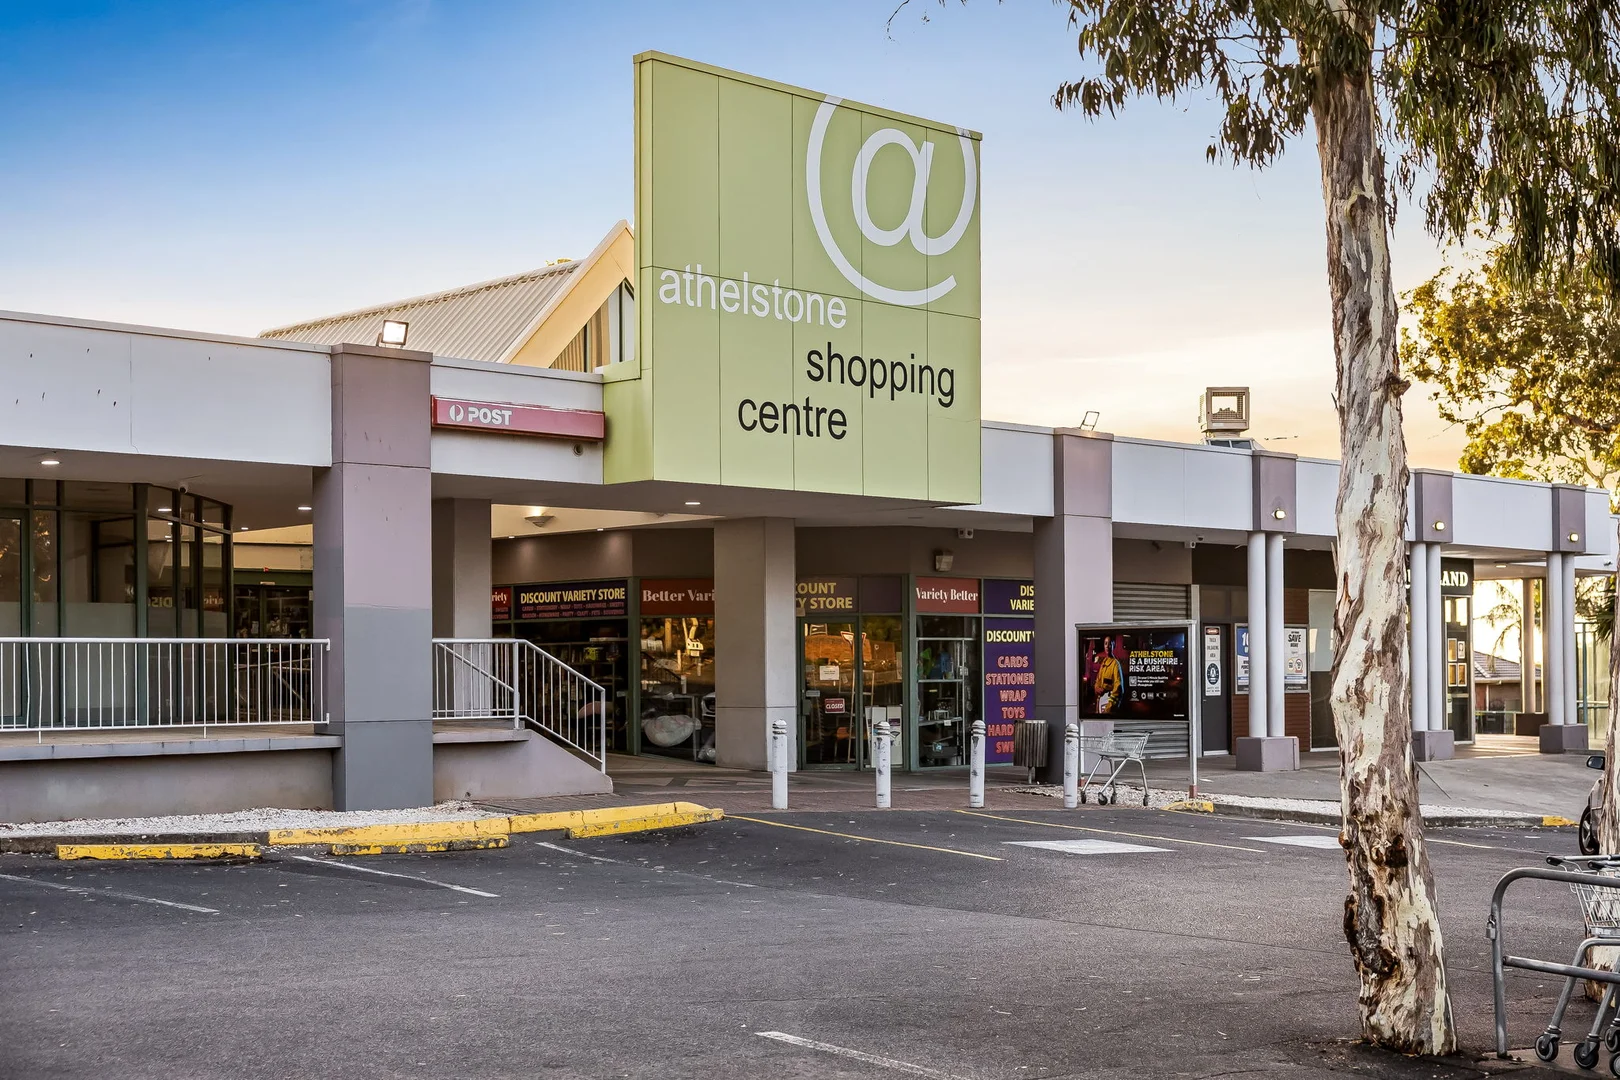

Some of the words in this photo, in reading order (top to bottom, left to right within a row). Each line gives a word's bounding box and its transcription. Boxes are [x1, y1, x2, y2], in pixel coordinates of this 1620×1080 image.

[659, 263, 847, 329] athelstone
[806, 342, 955, 408] shopping
[468, 406, 512, 425] POST
[738, 396, 848, 440] centre
[520, 591, 562, 604] DISCOUNT
[562, 589, 597, 602] VARIETY
[598, 587, 625, 600] STORE
[642, 589, 685, 602] Better
[916, 587, 949, 604] Variety
[950, 588, 979, 601] Better
[810, 597, 853, 609] STORE
[986, 630, 1031, 643] DISCOUNT
[1288, 634, 1302, 643] SAVE
[1129, 650, 1174, 658] ATHELSTONE
[997, 656, 1029, 668] CARDS
[1000, 690, 1027, 702] WRAP
[1001, 707, 1025, 719] TOYS
